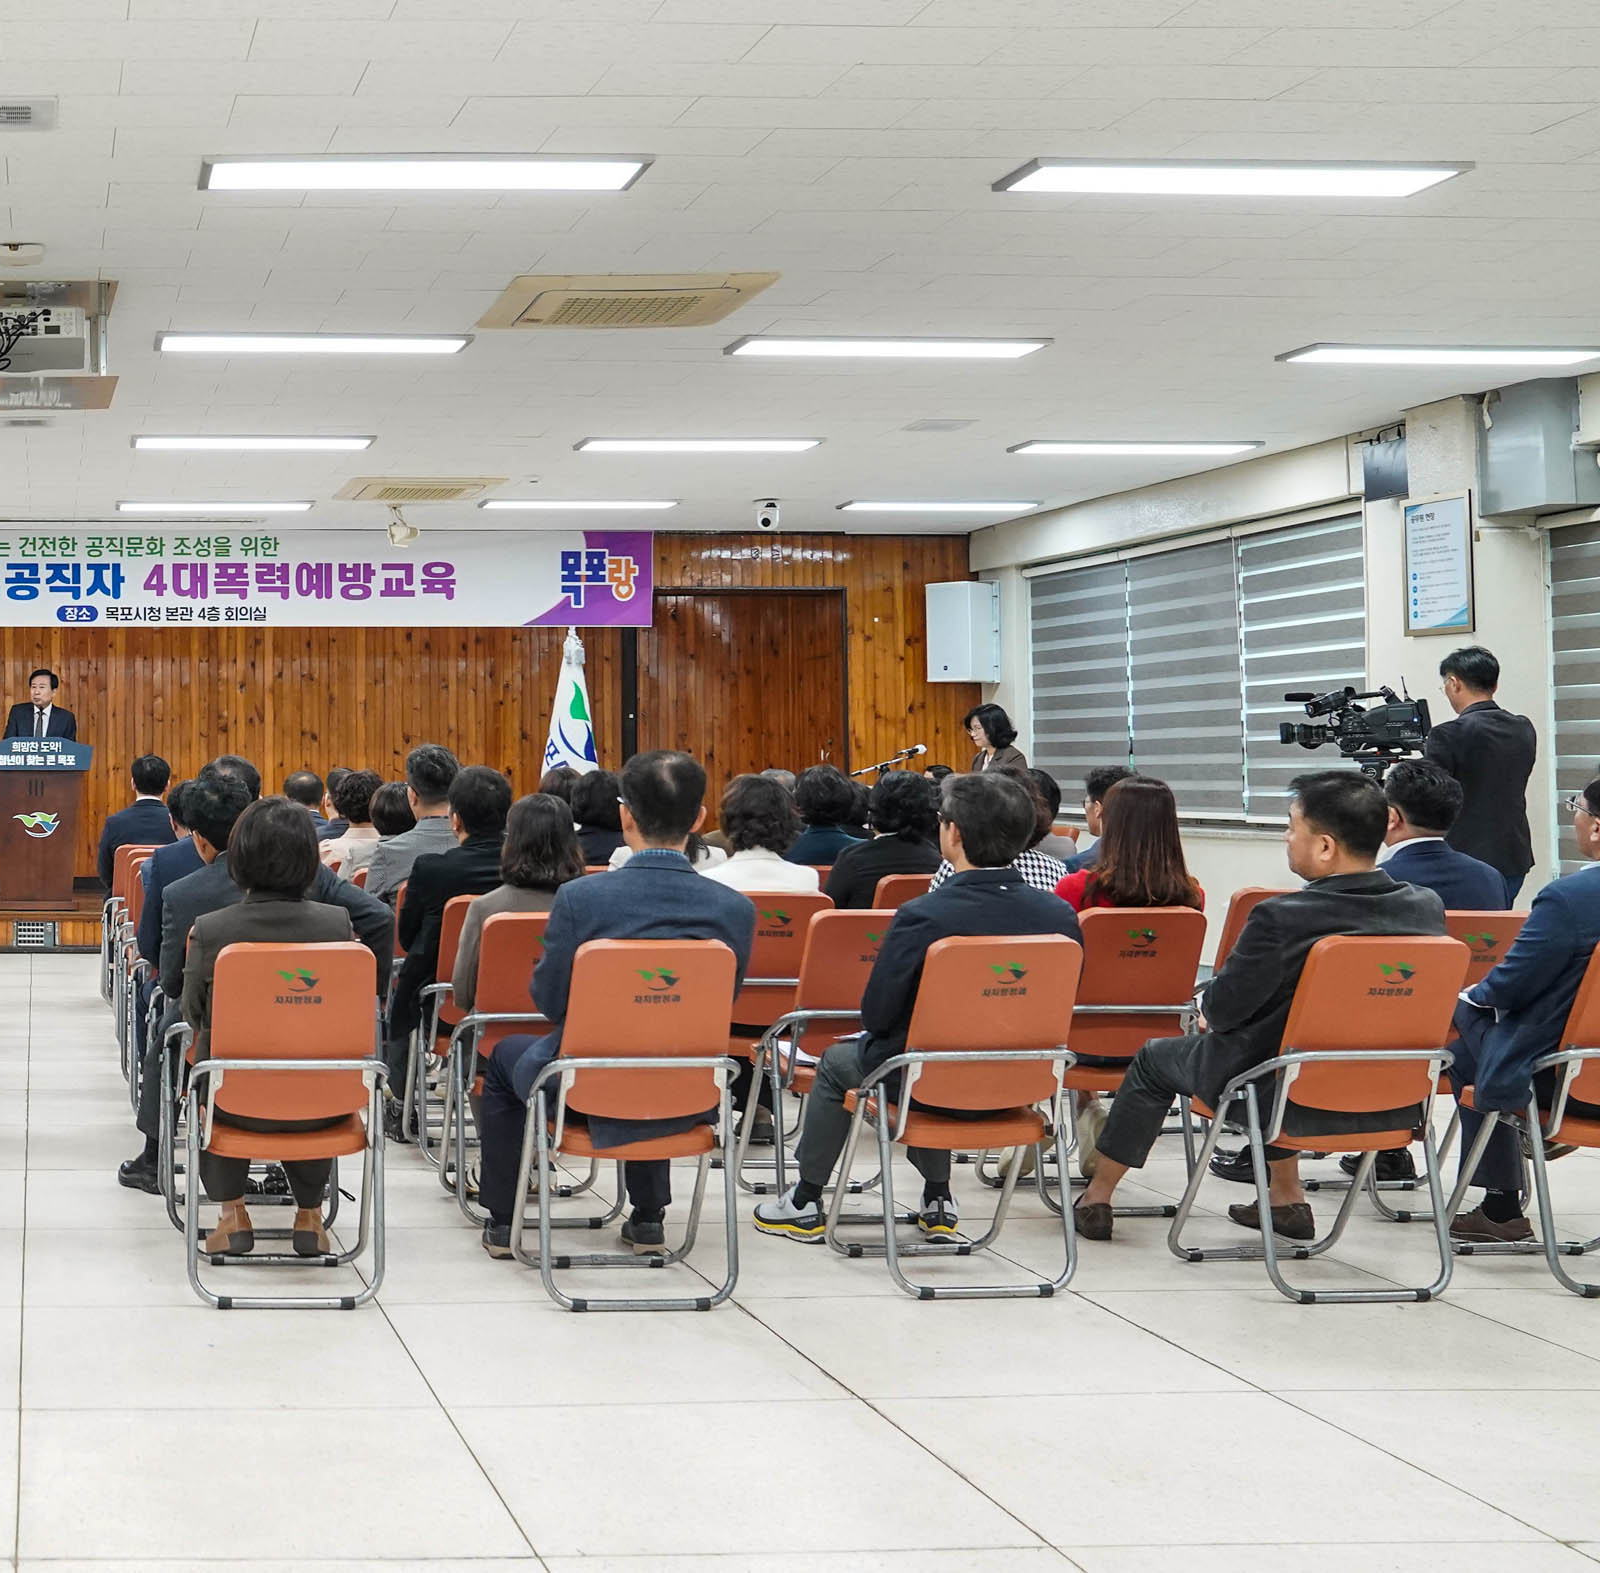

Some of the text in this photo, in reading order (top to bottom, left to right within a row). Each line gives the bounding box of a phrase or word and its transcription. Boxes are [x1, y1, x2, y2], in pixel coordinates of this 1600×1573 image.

[19, 537, 77, 558] 건전한
[85, 536, 165, 558] 공직문화
[173, 536, 233, 558] 조성을
[240, 536, 280, 558] 위한
[143, 562, 457, 601] 4대폭력예방교육
[560, 550, 638, 606] 목포랑
[64, 606, 267, 622] 장소 목포시청 본관 4층 회의실
[11, 741, 62, 753] 희망찬 도약!
[26, 754, 45, 766] 찾는
[46, 754, 56, 766] 큰
[57, 754, 76, 766] 목포
